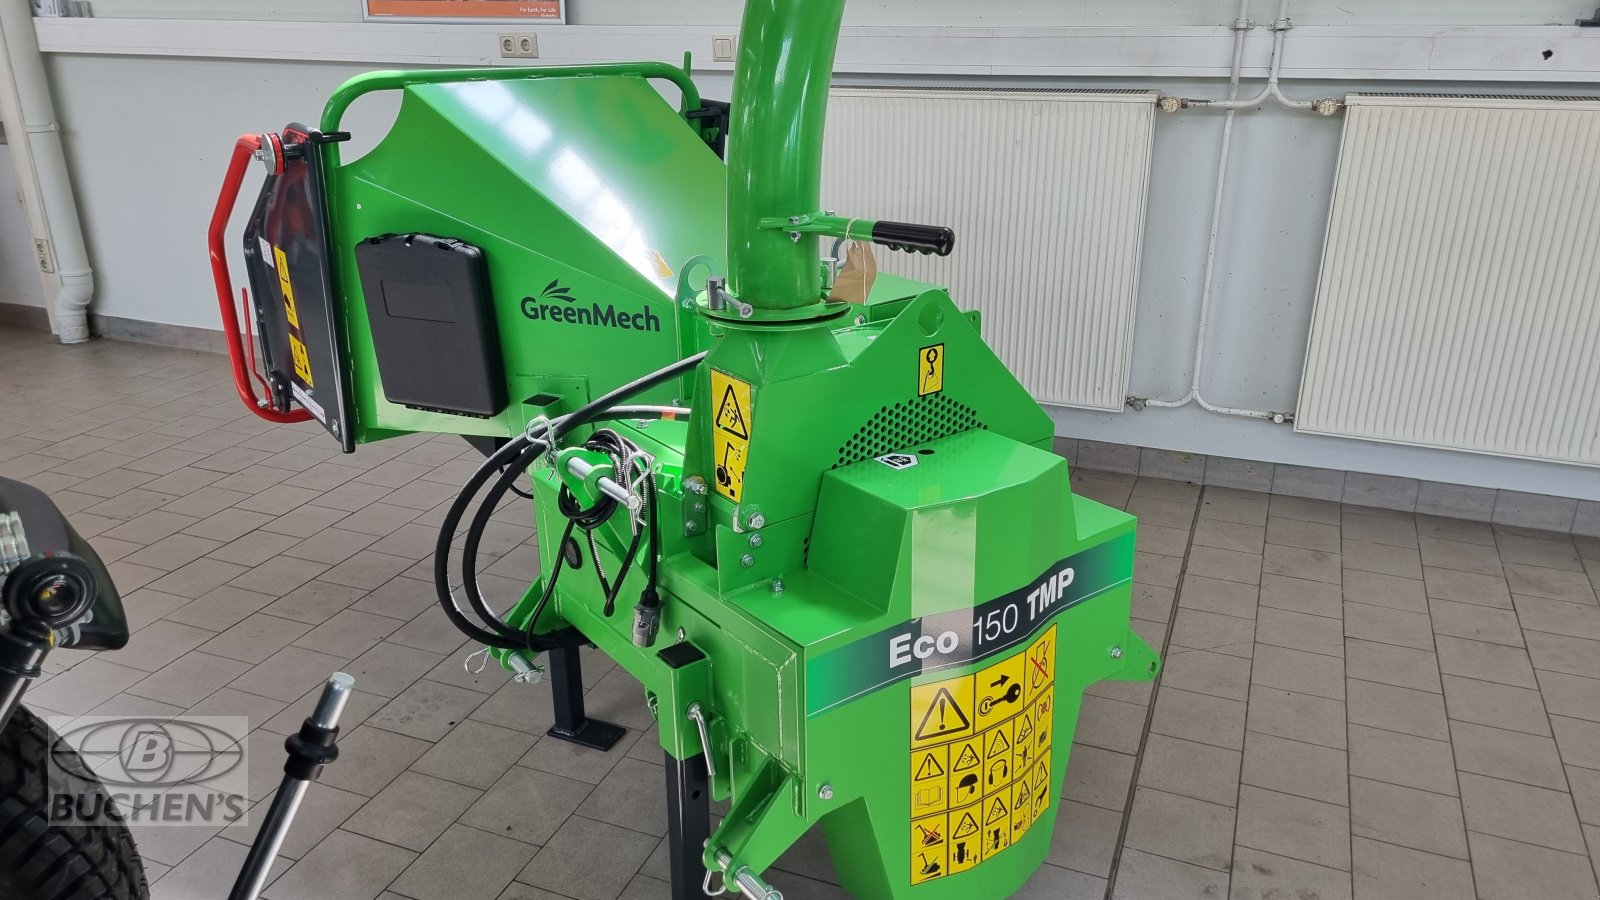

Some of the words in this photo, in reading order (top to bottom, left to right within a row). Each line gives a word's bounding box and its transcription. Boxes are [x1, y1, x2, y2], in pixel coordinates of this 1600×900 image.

[520, 296, 661, 332] GreenMech
[889, 631, 960, 669] Eco
[973, 603, 1019, 646] 150
[1026, 567, 1075, 622] TMP
